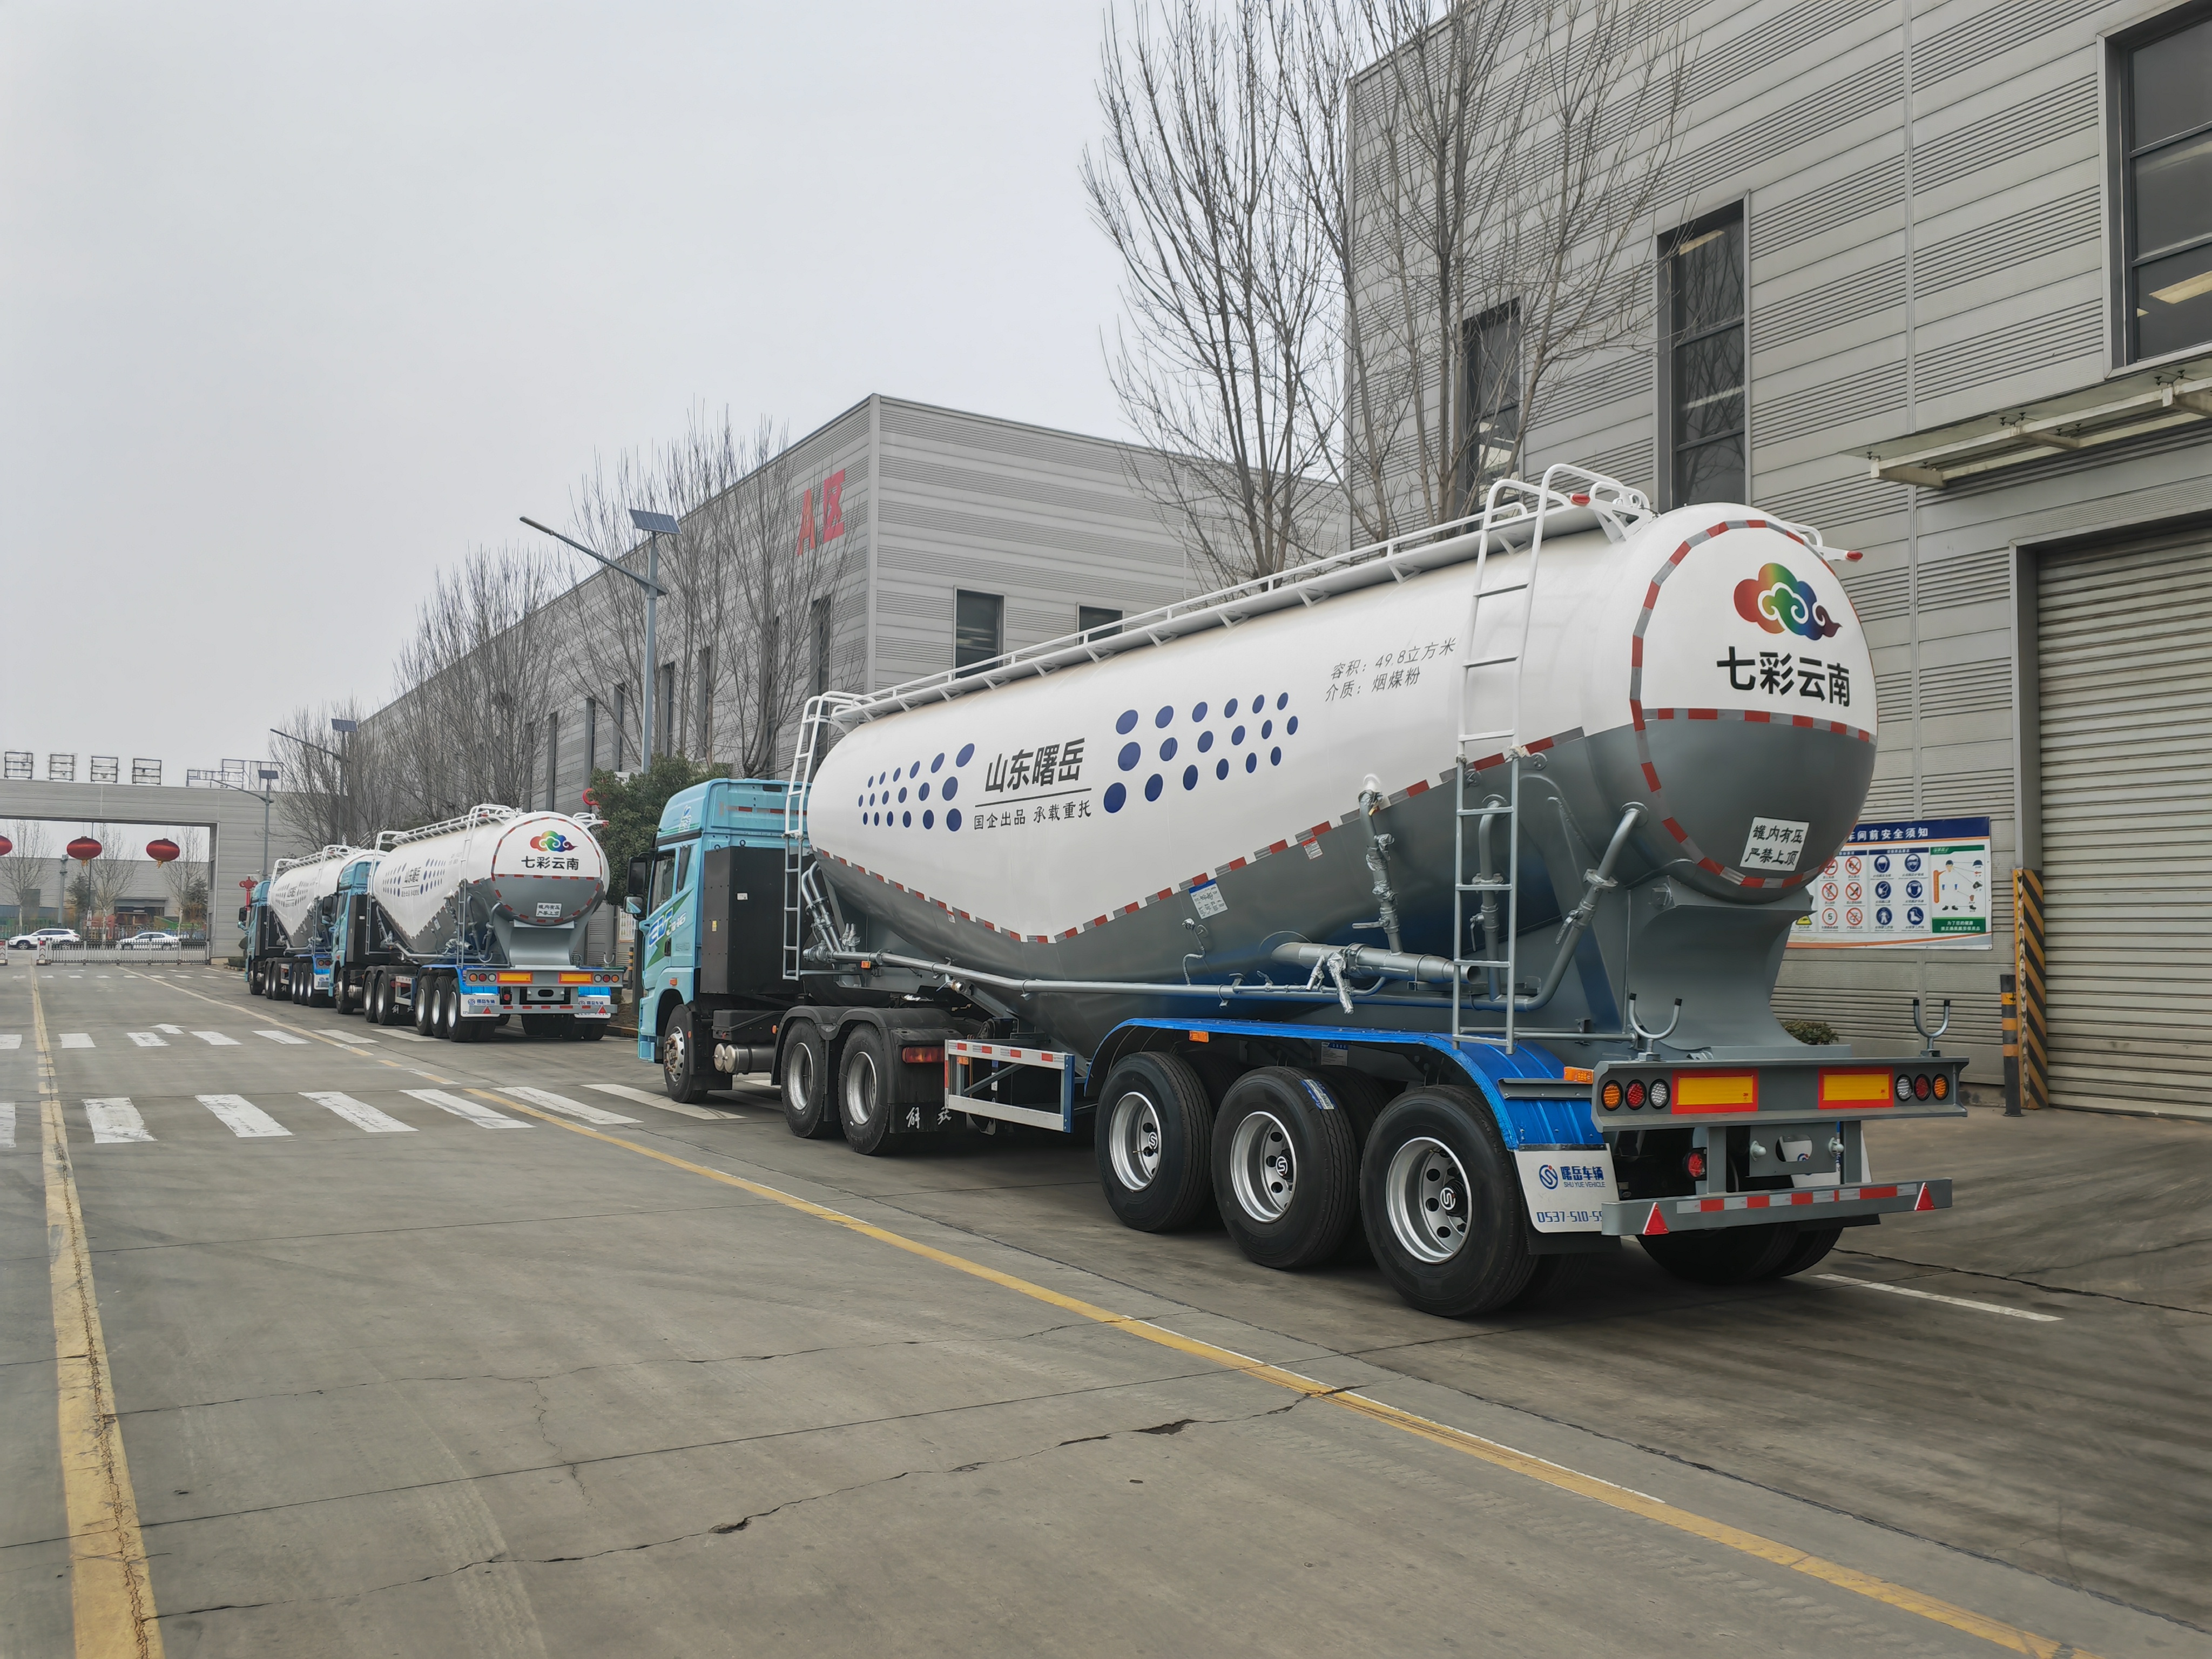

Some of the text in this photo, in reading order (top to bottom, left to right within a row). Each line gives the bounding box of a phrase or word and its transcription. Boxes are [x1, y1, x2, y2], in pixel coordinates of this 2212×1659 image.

[1716, 646, 1850, 707] 七彩云南
[985, 737, 1085, 793] 山东曙岳
[974, 799, 1092, 830] 国企出品 承载重托
[1752, 825, 1804, 844] 罐内有压
[521, 855, 579, 871] 七彩云南
[1744, 847, 1799, 866] 严禁上顶
[1560, 1166, 1604, 1181] 曙岳车辆
